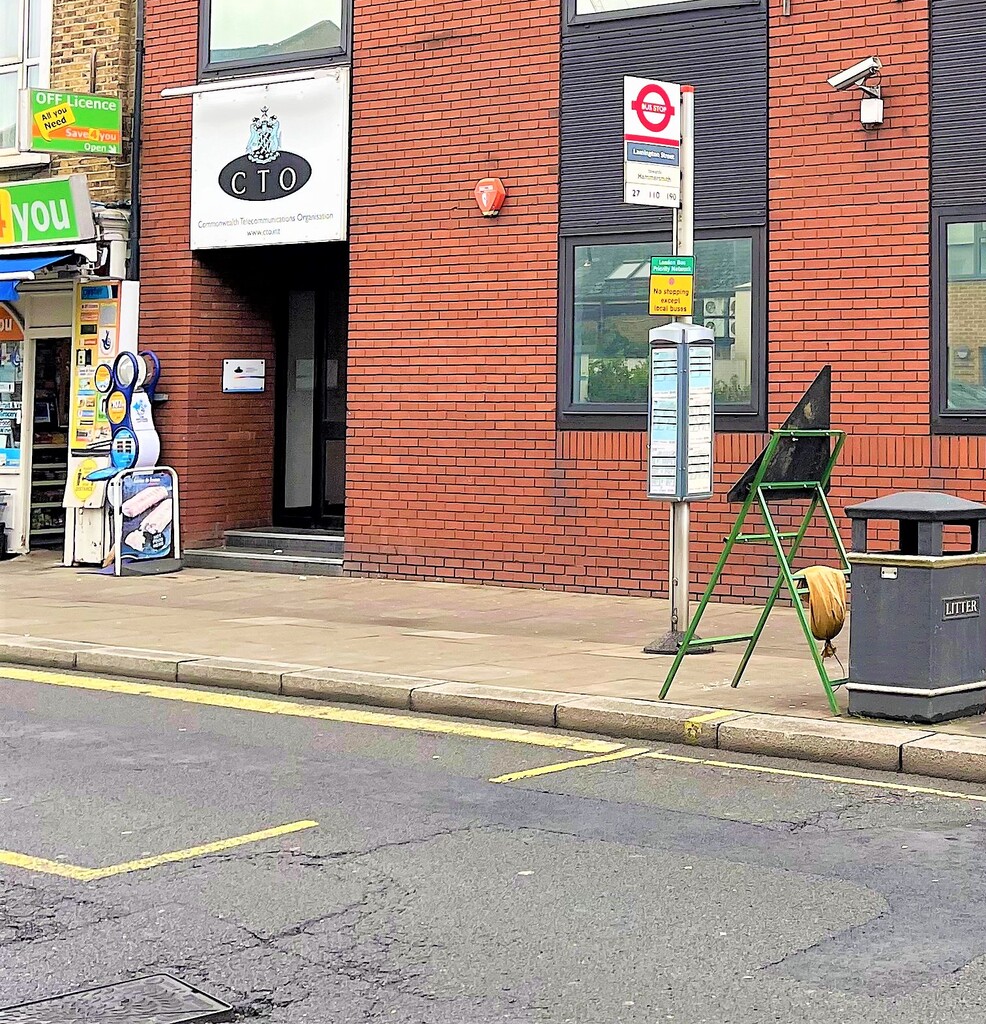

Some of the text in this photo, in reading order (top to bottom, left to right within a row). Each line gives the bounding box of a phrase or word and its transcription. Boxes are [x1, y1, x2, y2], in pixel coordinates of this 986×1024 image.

[36, 92, 116, 110] OFF Licence
[641, 102, 667, 113] BUS STOP
[41, 107, 67, 121] All you
[44, 116, 67, 130] Need
[84, 142, 106, 152] Open
[661, 151, 676, 160] Street
[632, 189, 677, 201] 27 110 190
[0, 198, 71, 243] you
[198, 212, 334, 229] Commonwealth Telecommunications Organisation
[664, 288, 690, 297] stopping
[660, 297, 681, 305] except
[945, 599, 978, 615] LITTER
